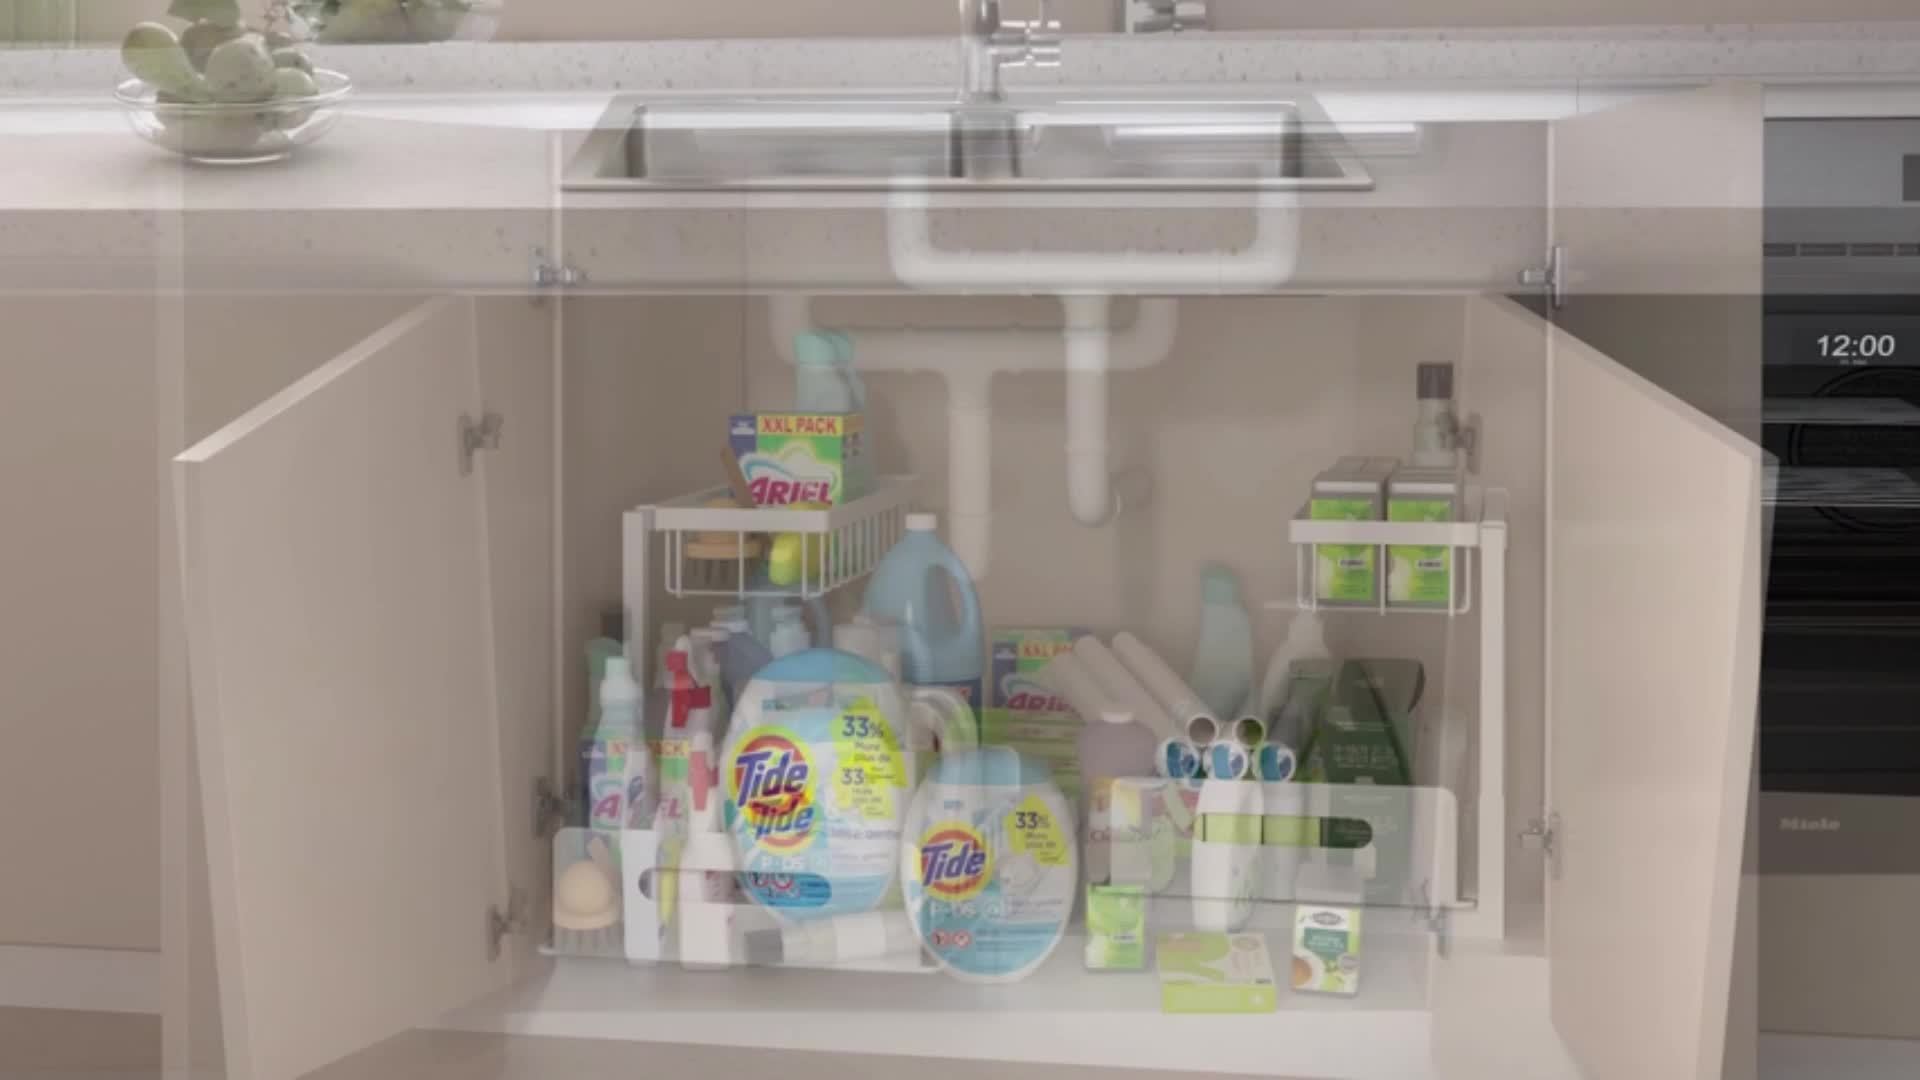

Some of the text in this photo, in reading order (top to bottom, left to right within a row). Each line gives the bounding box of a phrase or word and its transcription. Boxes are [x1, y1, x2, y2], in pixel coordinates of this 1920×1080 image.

[1817, 335, 1895, 356] 12:00
[762, 416, 793, 433] XXL
[796, 416, 837, 434] PACK
[750, 477, 833, 505] ARIEL
[842, 715, 885, 738] 33%
[735, 751, 809, 807] Tide
[921, 843, 987, 887] Tide
